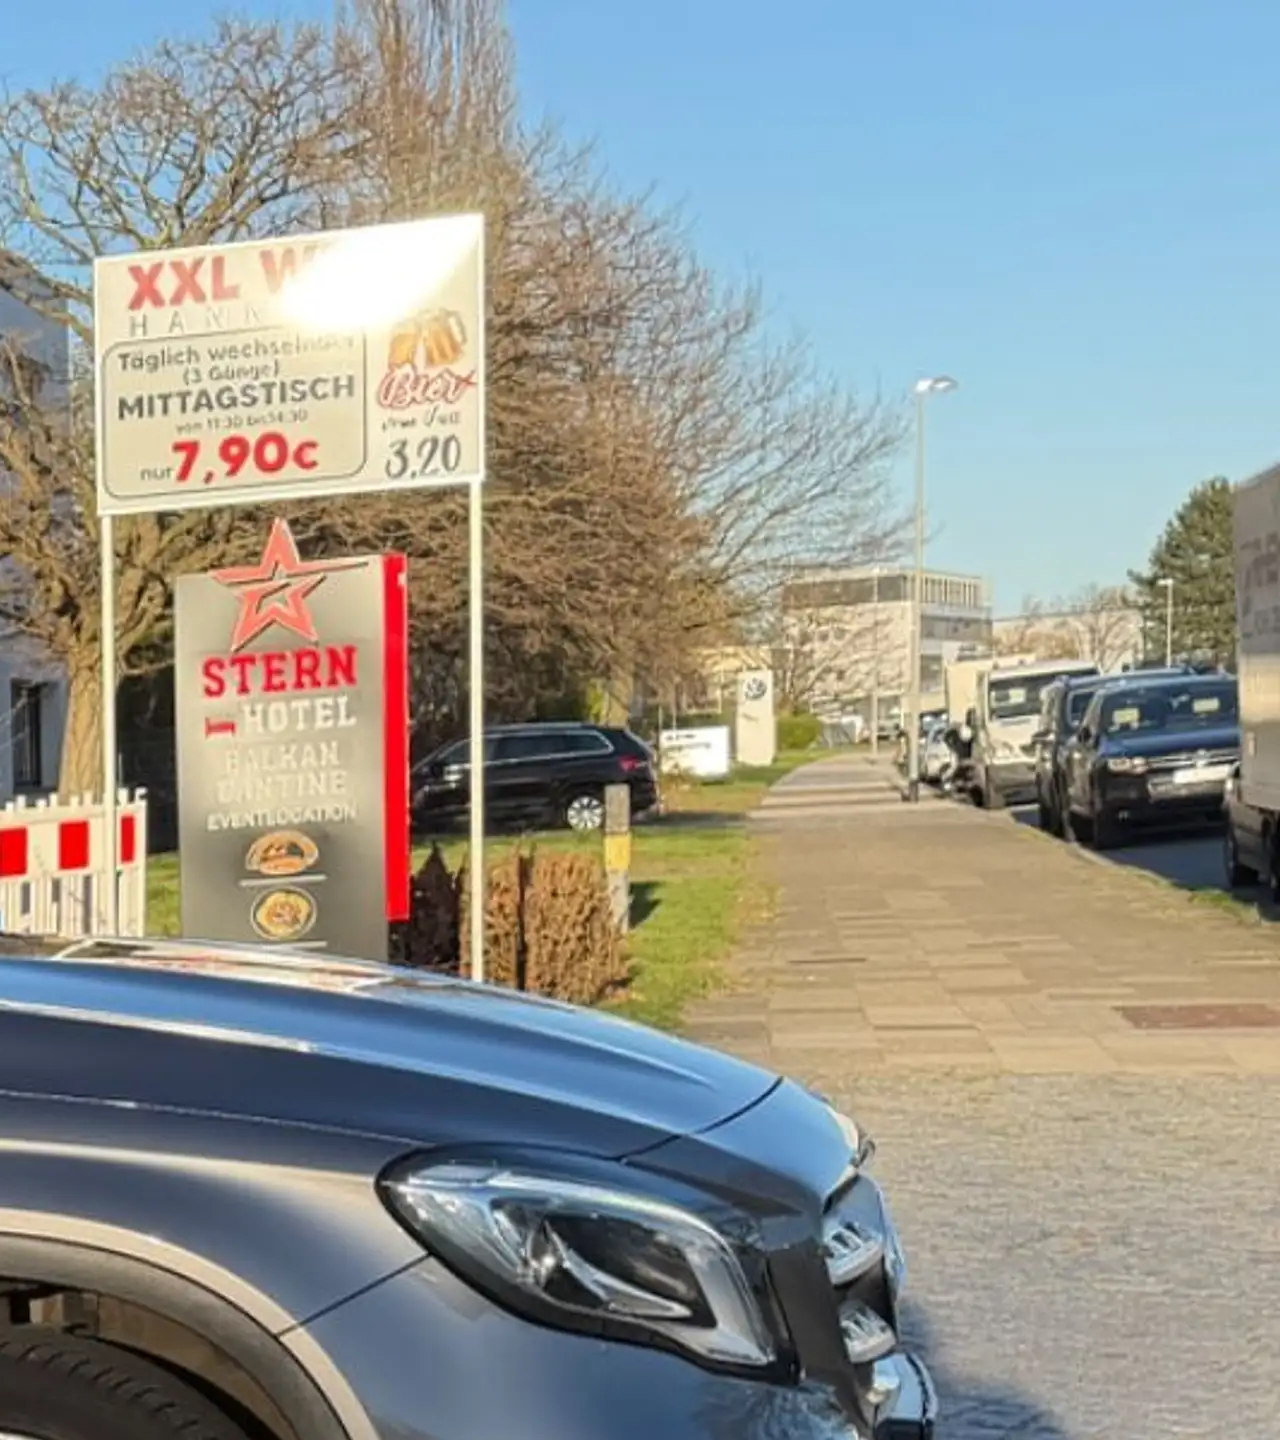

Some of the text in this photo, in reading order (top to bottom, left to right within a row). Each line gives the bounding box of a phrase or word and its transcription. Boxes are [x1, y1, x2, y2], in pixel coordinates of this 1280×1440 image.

[128, 256, 239, 310] XXL
[118, 345, 201, 373] Täglich
[118, 374, 354, 421] MITTAGSTISCH
[376, 366, 476, 411] Bier
[140, 467, 172, 481] nur
[202, 644, 357, 697] STERN
[243, 695, 357, 734] HOTEL
[226, 741, 340, 776] BALKAN
[207, 802, 357, 832] EVENTLOCATION
